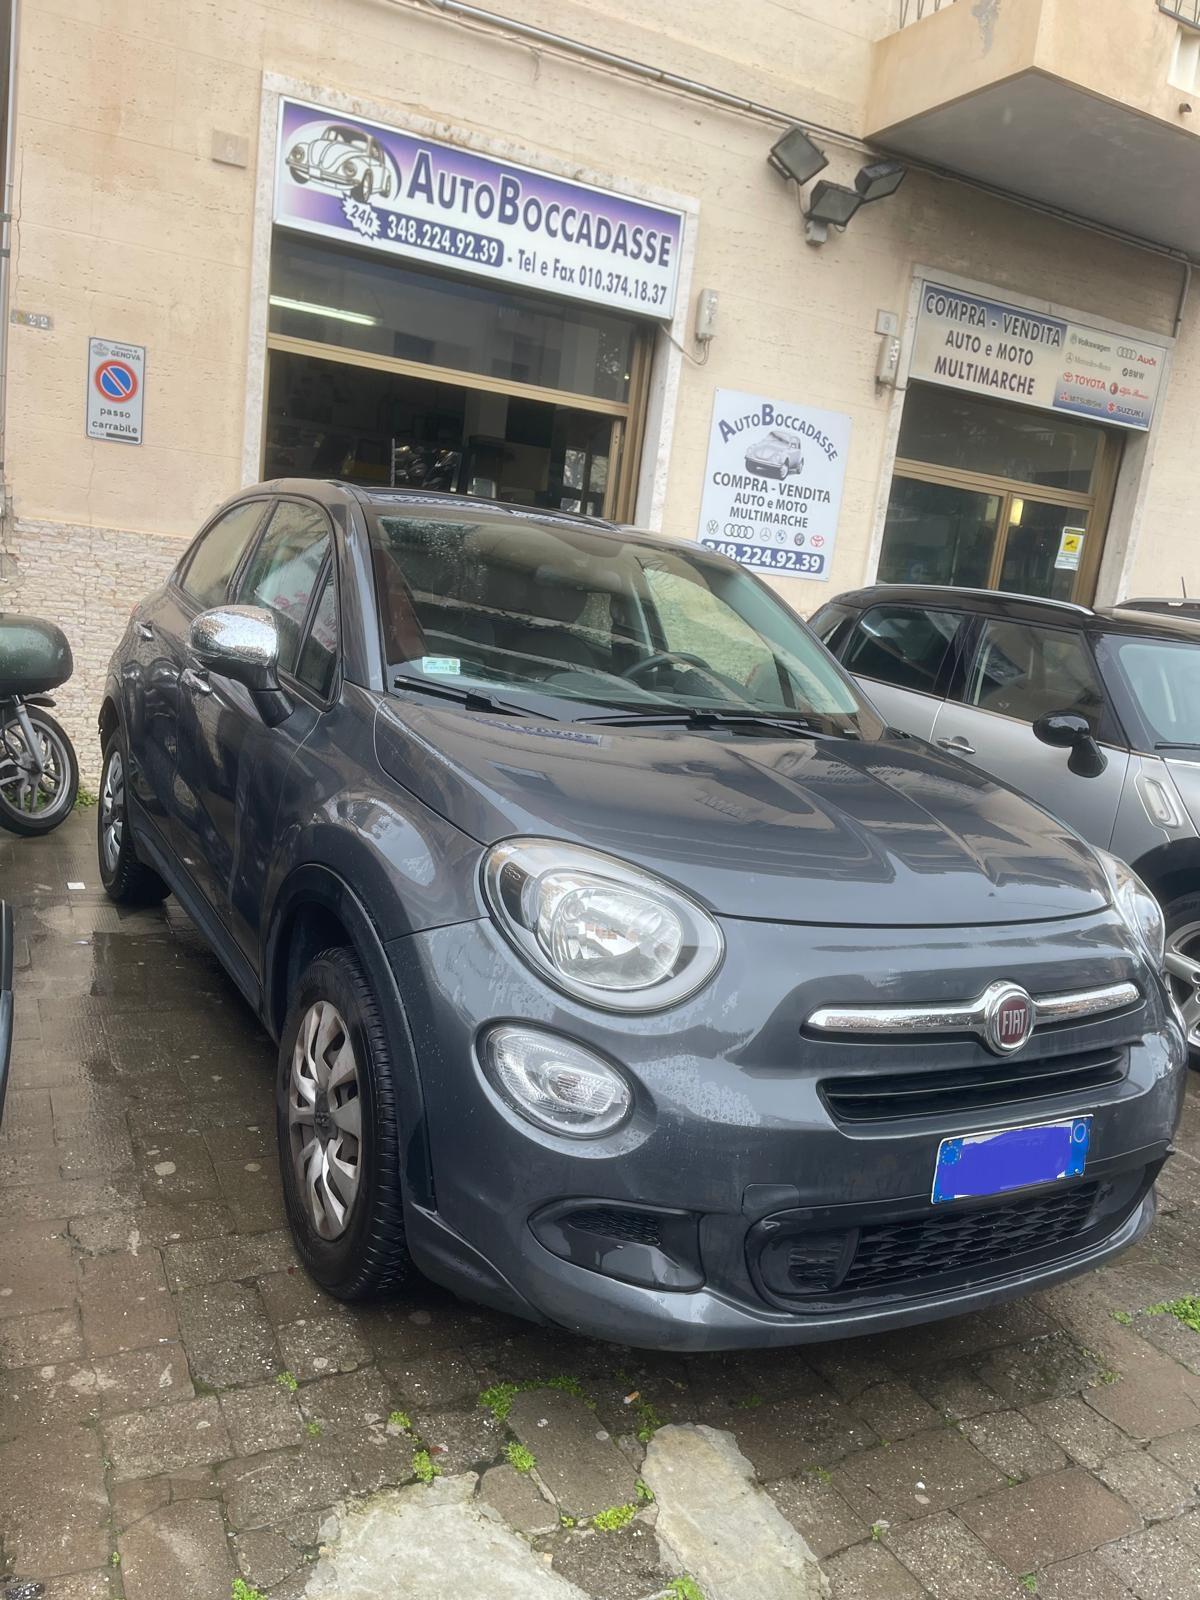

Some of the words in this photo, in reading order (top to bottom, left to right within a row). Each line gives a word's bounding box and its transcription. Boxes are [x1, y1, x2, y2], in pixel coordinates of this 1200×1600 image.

[407, 150, 672, 267] AUTOBOCCADASSE
[350, 204, 374, 228] 24h
[387, 214, 499, 264] 348.224.92.39
[518, 249, 536, 273] Tel
[540, 260, 549, 276] e
[553, 258, 575, 283] Fax
[579, 265, 668, 305] 010.374.18.37
[926, 294, 986, 327] COMPRA
[1003, 314, 1061, 347] VENDITA
[111, 350, 141, 360] GENOVA
[945, 330, 981, 353] AUTO
[985, 344, 992, 356] e
[996, 343, 1033, 366] MOTO
[1137, 354, 1157, 367] Audi
[934, 356, 1035, 395] MULTIMARCHE
[1075, 374, 1106, 391] TOYOTA
[100, 408, 131, 418] passo
[1117, 405, 1144, 418] SUZUKI
[92, 421, 138, 433] carrabile
[718, 404, 838, 462] AUTOBOCCADASSE
[713, 471, 768, 493] COMPRA
[779, 483, 831, 503] VENDITA
[734, 492, 765, 508] AUTO
[767, 500, 774, 508] e
[776, 499, 808, 514] MOTO
[730, 506, 809, 528] MULTIMARCHE
[1002, 1009, 1026, 1035] FIAT
